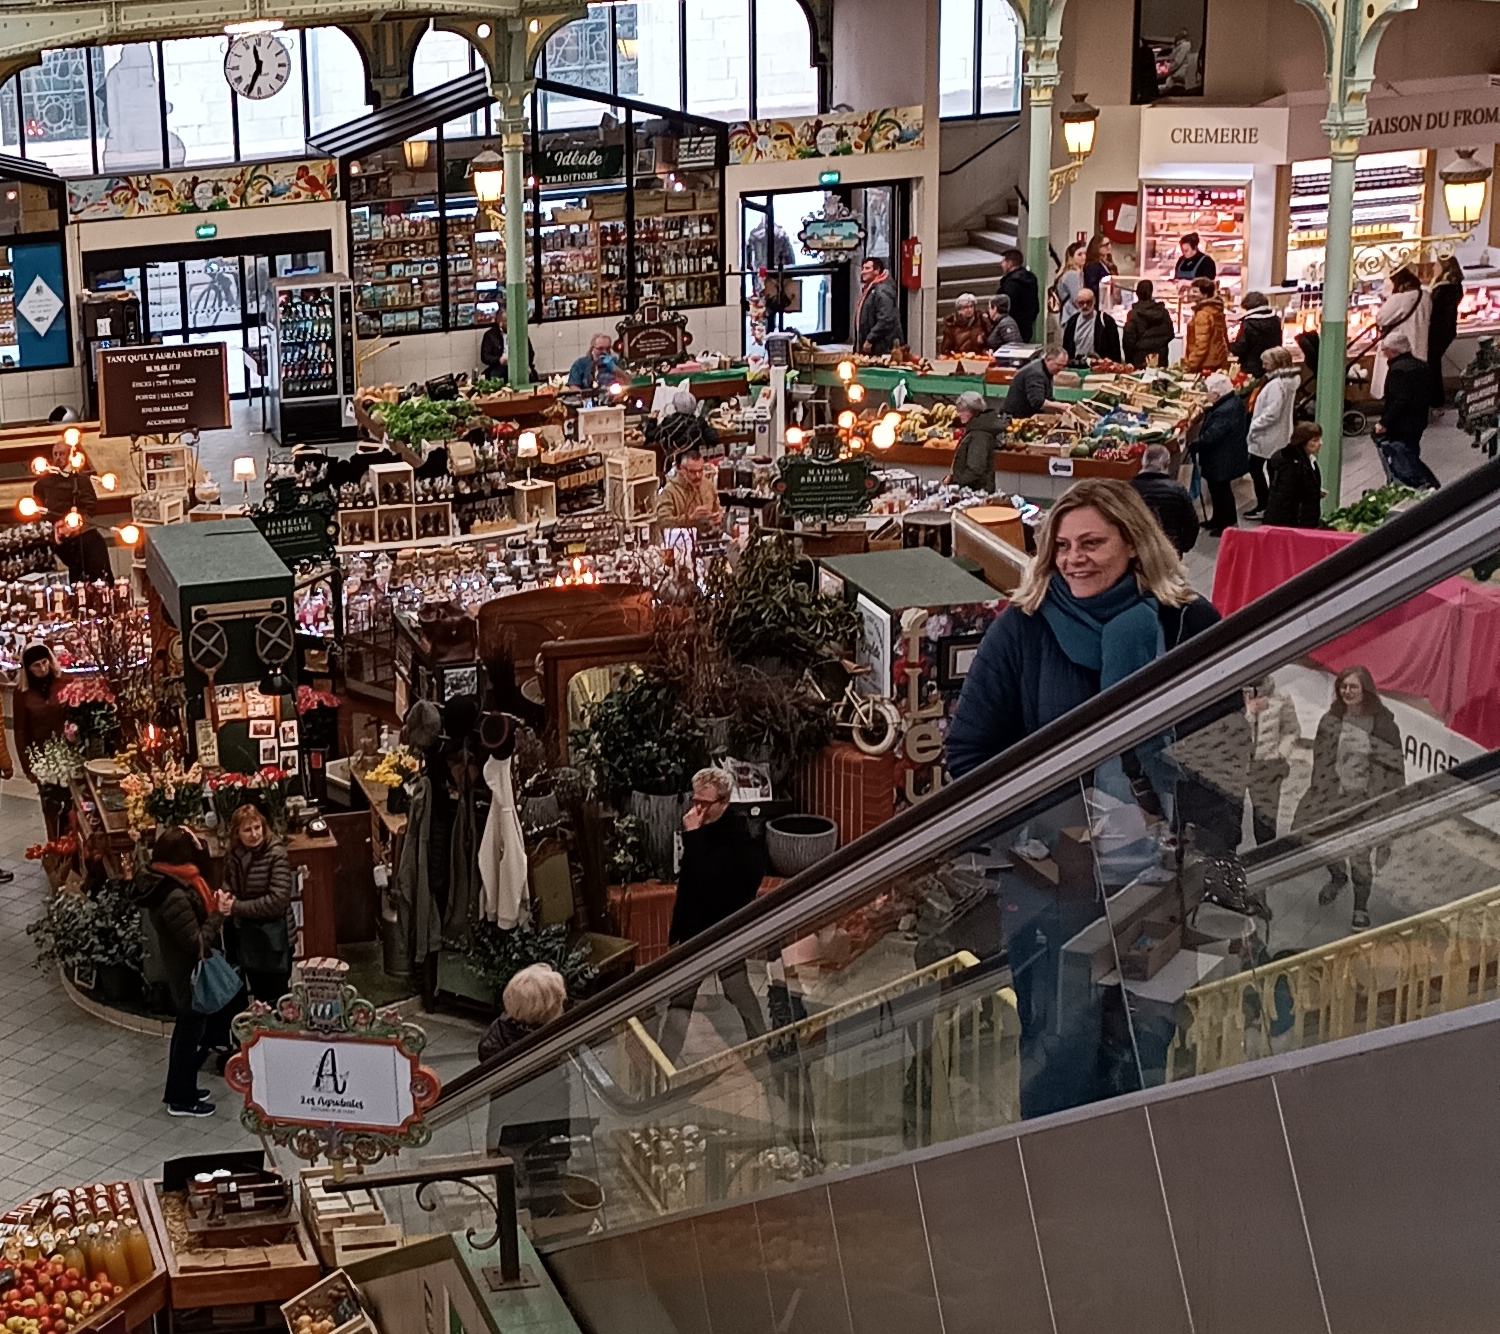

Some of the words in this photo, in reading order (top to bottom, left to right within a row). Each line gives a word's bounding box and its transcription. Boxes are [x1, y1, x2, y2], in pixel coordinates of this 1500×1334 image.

[1427, 111, 1451, 129] DU
[1170, 126, 1259, 145] CREMERIE
[545, 171, 598, 184] TRADITIONS
[106, 355, 127, 364] TANT
[149, 353, 155, 361] Y
[177, 350, 193, 359] DES
[193, 348, 220, 358] ÉPICES
[267, 516, 309, 529] ISABELLE
